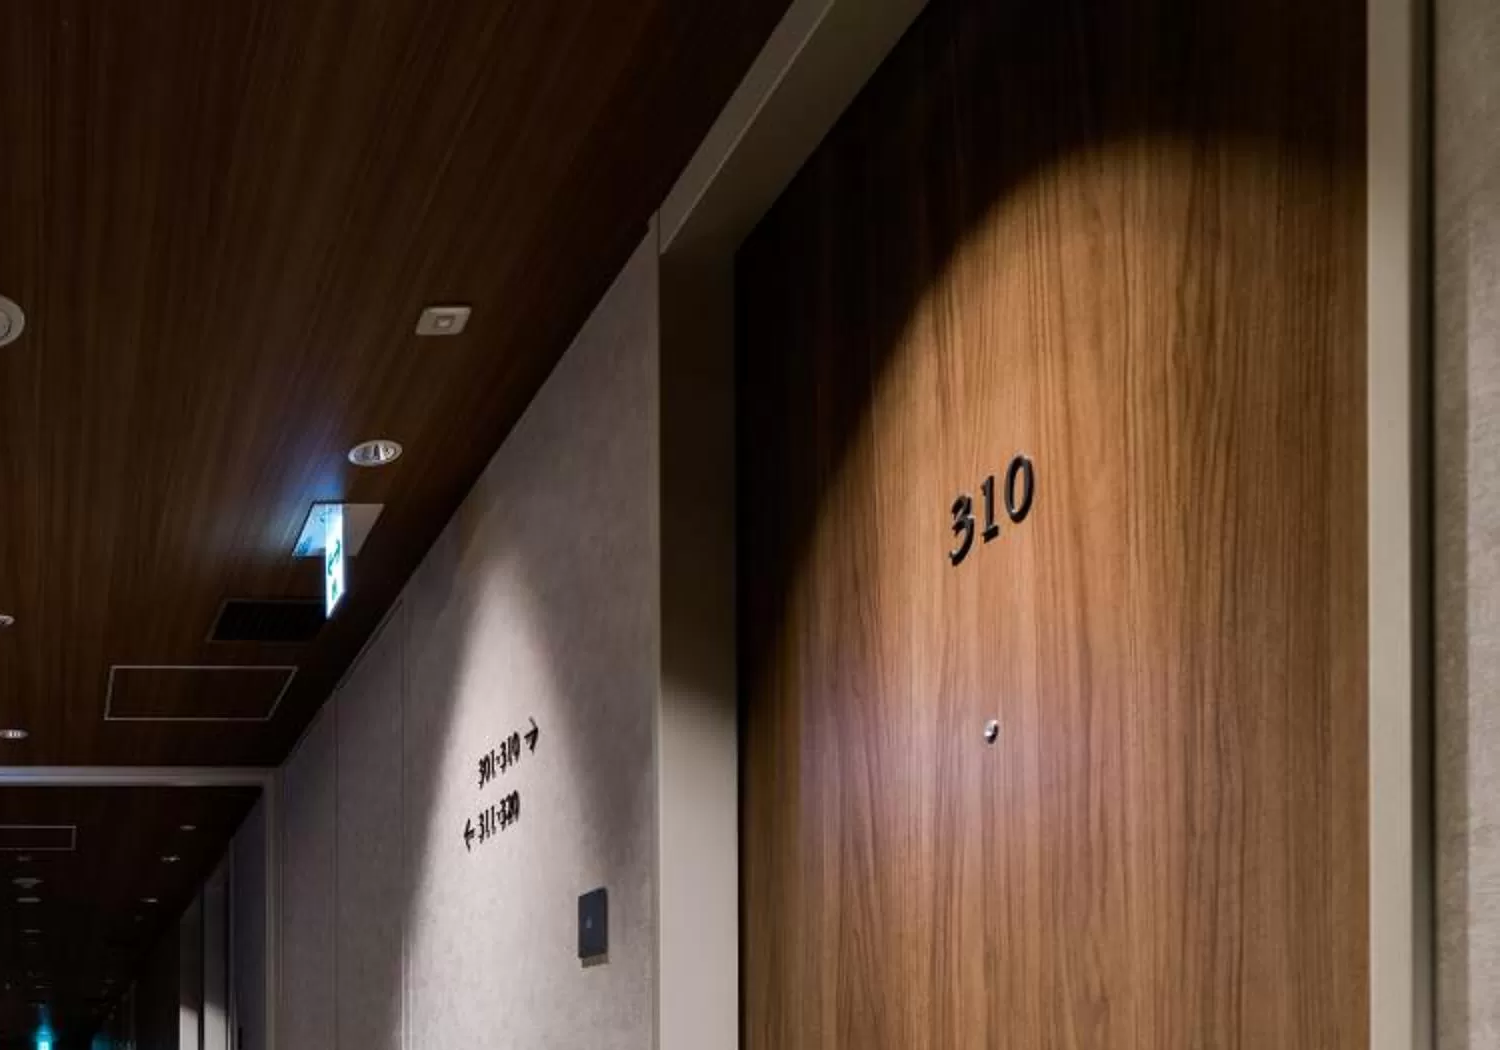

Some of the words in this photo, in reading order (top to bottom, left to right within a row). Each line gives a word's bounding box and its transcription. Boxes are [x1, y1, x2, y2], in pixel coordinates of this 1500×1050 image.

[949, 455, 1035, 567] 310
[478, 731, 521, 790] 301-310
[478, 789, 520, 844] 311-320
